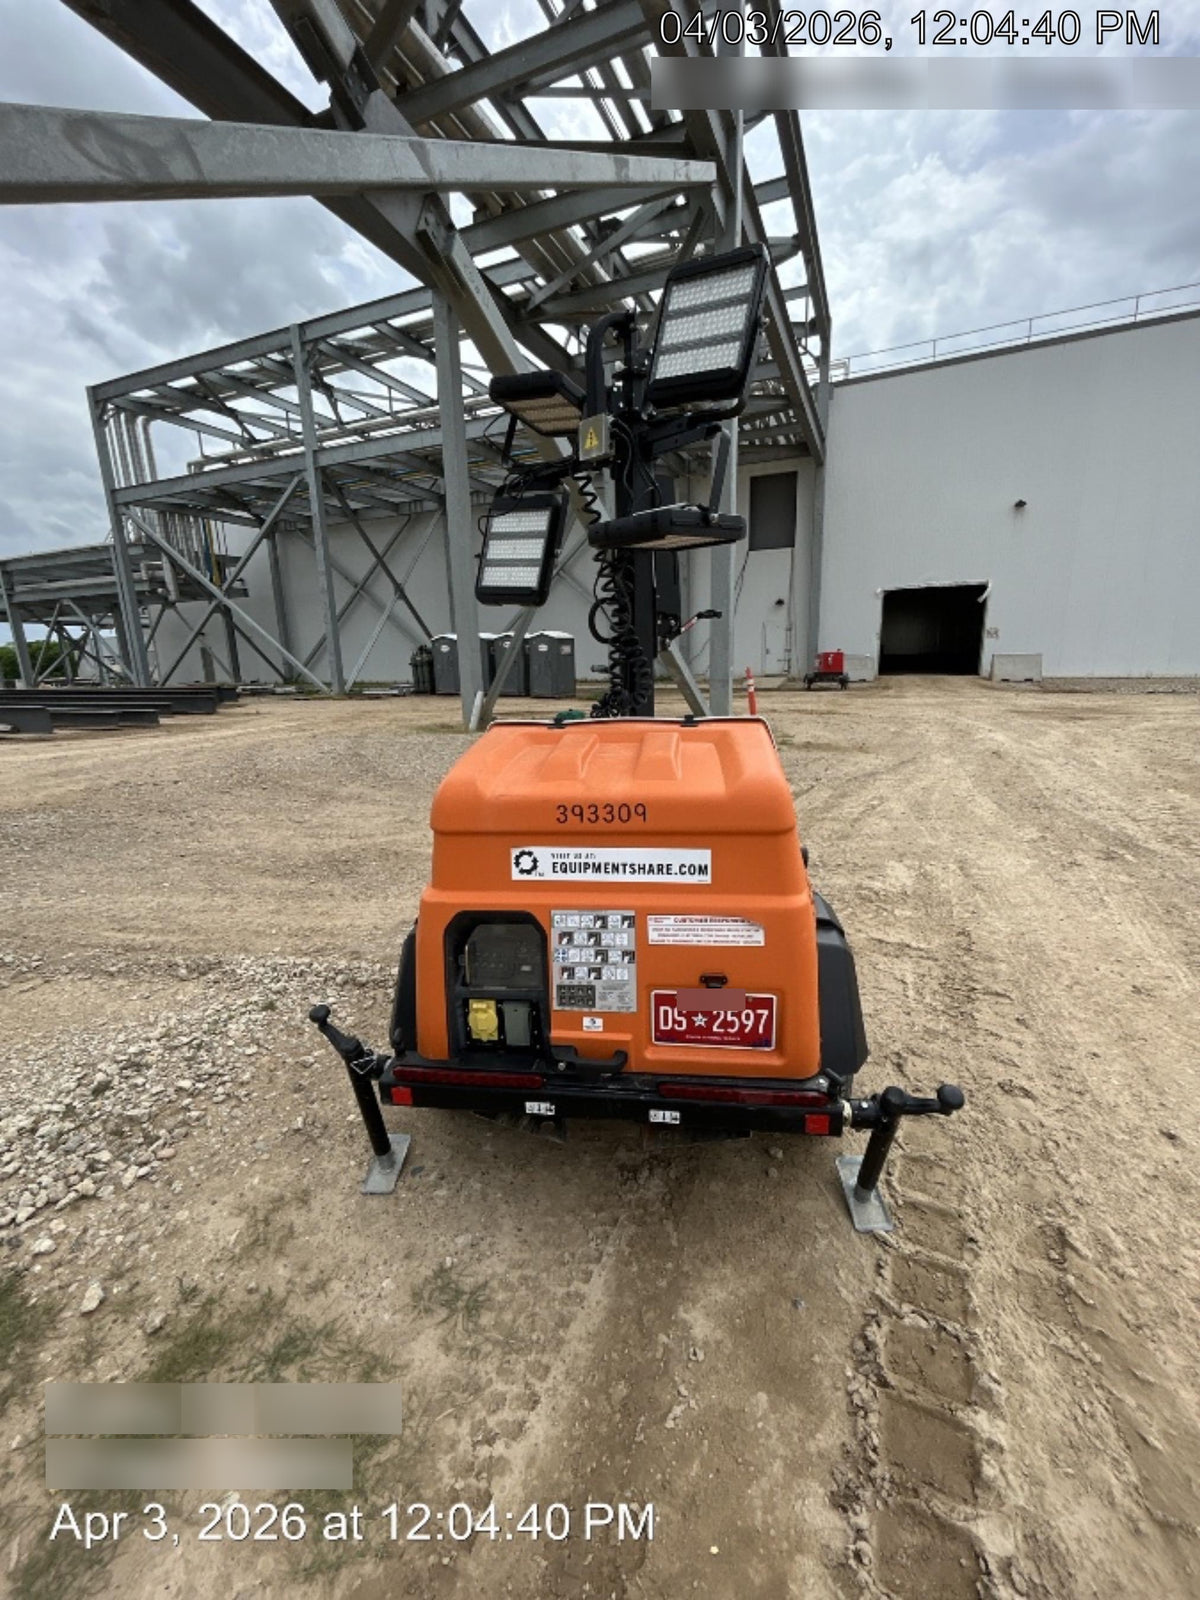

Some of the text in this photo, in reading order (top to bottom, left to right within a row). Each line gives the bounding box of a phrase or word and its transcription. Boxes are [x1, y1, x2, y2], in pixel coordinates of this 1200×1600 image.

[556, 803, 646, 824] 393309
[552, 861, 709, 877] EQUIPMENTSHARE.COM
[660, 1006, 769, 1034] DS 2597
